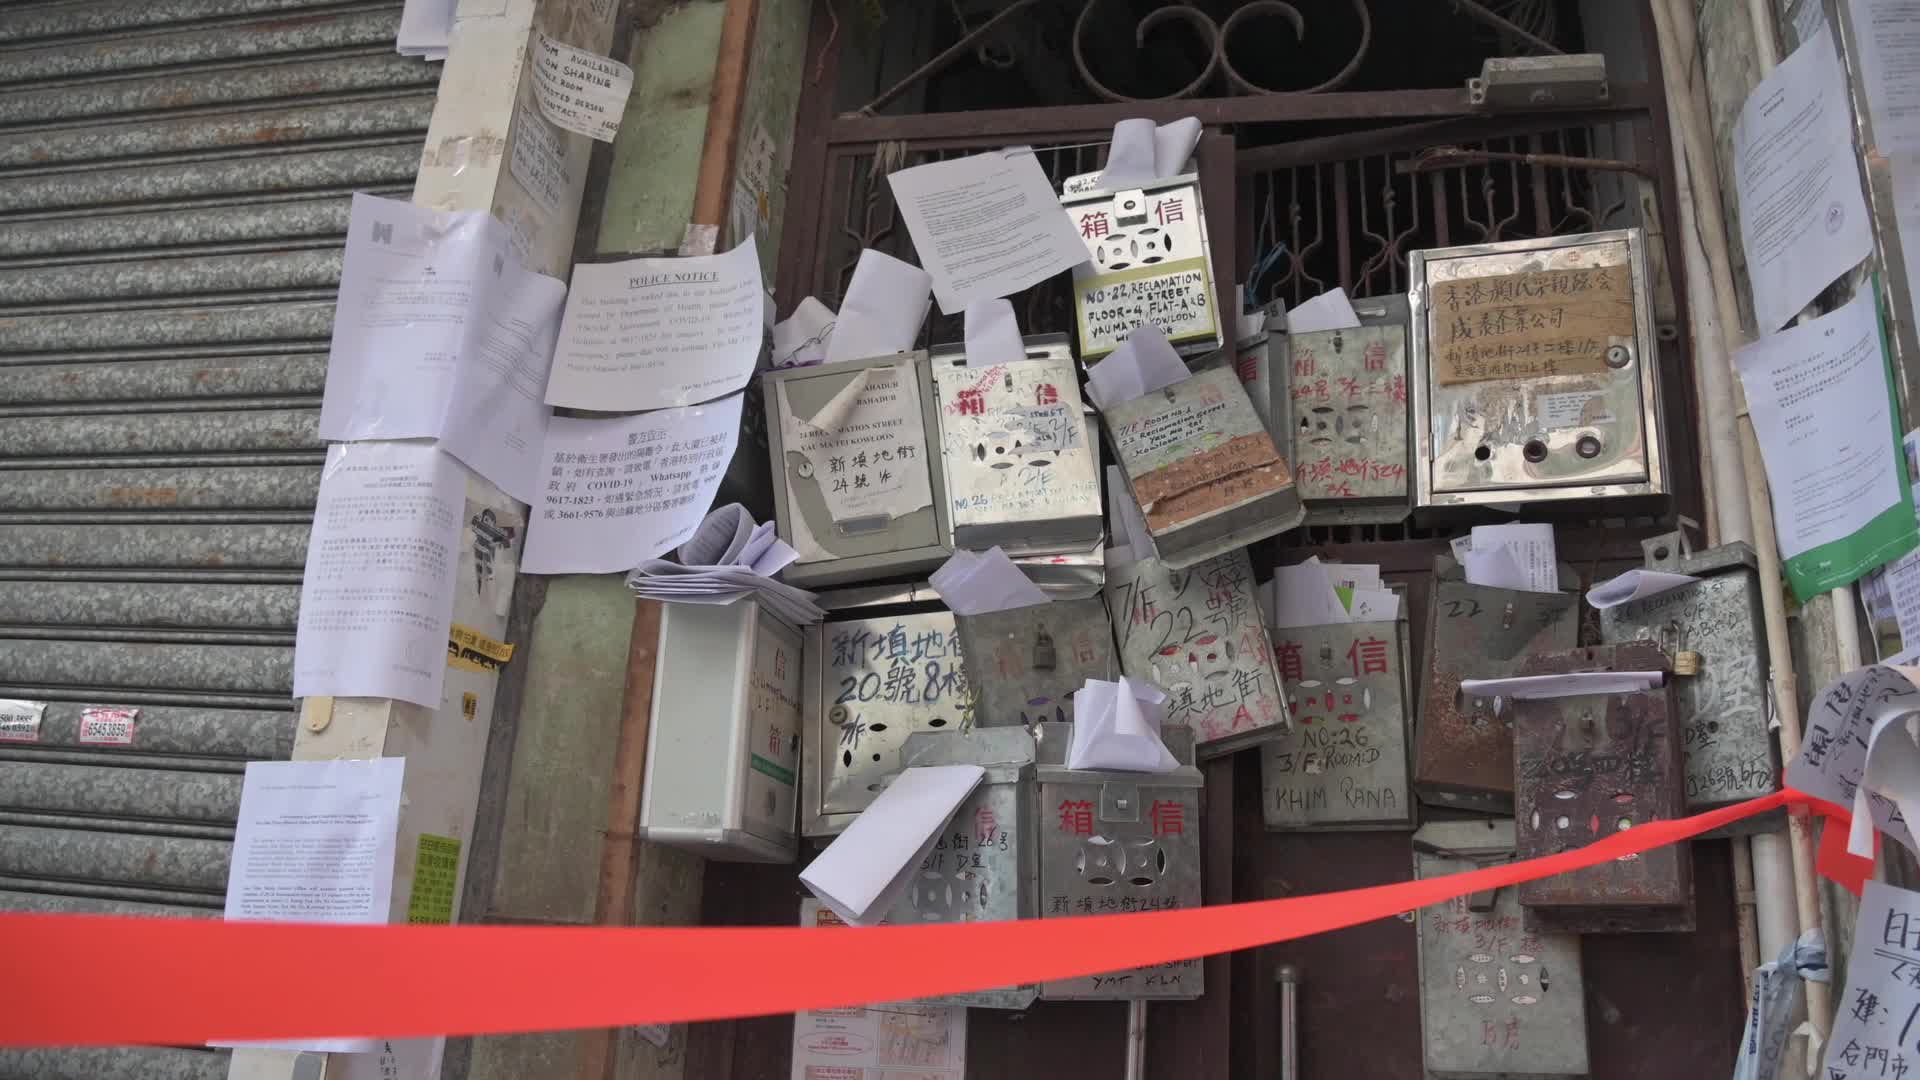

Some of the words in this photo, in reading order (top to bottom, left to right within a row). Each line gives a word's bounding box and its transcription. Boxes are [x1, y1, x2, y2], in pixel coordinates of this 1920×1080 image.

[1079, 210, 1111, 240] 箱
[1154, 197, 1185, 227] 信
[628, 272, 673, 288] POLICE
[674, 270, 721, 284] NOTICE
[1131, 271, 1203, 295] RECLAMATION
[1196, 293, 1207, 308] B
[1091, 324, 1111, 339] YAU
[1112, 321, 1129, 333] MA
[829, 445, 918, 476] 新填地街
[586, 478, 633, 491] COVID-19
[544, 494, 595, 505] 9617-1823
[1345, 635, 1390, 679] 信
[1274, 786, 1328, 811] KHIM
[1339, 776, 1398, 810] RANA
[1057, 798, 1096, 837] 箱
[1149, 798, 1185, 837] 信
